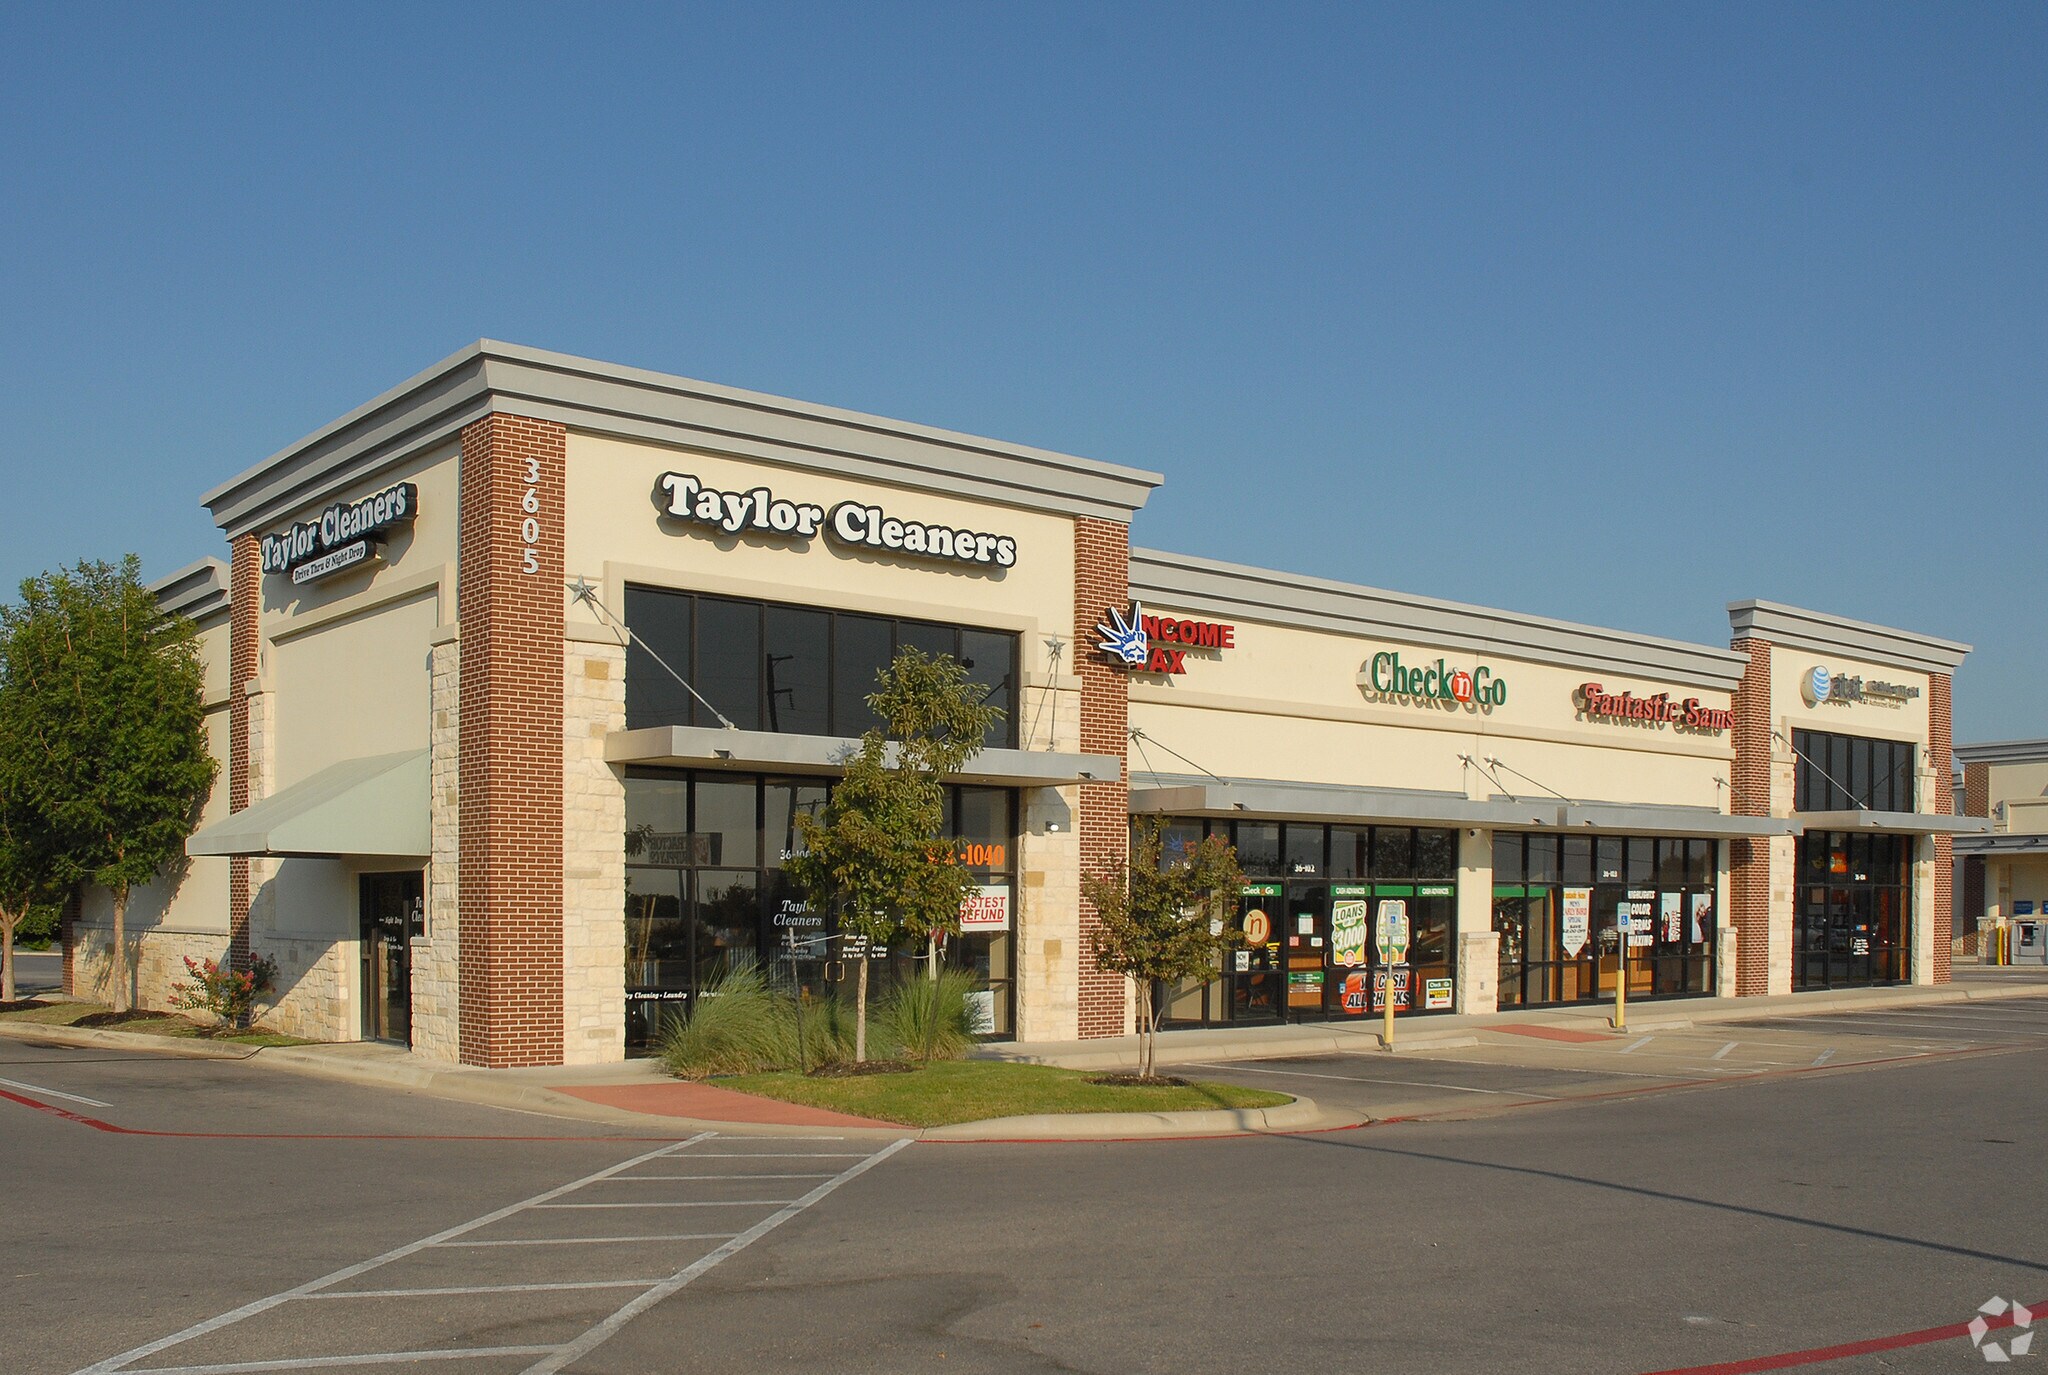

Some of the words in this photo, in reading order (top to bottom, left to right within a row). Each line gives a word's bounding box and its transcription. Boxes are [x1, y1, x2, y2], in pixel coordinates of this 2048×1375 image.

[522, 457, 540, 574] 3605
[662, 475, 823, 534] Taylor
[834, 504, 1016, 566] Cleaners
[262, 526, 317, 571] Taylor
[321, 486, 406, 547] Cleaners
[295, 570, 310, 581] Drive
[310, 564, 325, 575] Thru
[331, 552, 348, 567] Night
[348, 546, 364, 560] Drop
[1142, 614, 1234, 649] NCOME
[1371, 651, 1454, 700] Check
[1473, 665, 1507, 706] Go
[1585, 682, 1680, 722] Fantastic
[1686, 697, 1736, 729] Sams
[781, 900, 817, 912] Tayl
[962, 896, 1006, 909] ASTEST
[1631, 903, 1651, 915] COLOR
[773, 913, 822, 926] Cleaners
[1335, 904, 1363, 922] LOANS
[1631, 918, 1652, 931] PERMS
[1628, 935, 1653, 947] WAXING
[1378, 974, 1406, 990] CSH
[634, 991, 659, 1000] Cleaning
[663, 991, 687, 999] Laundry
